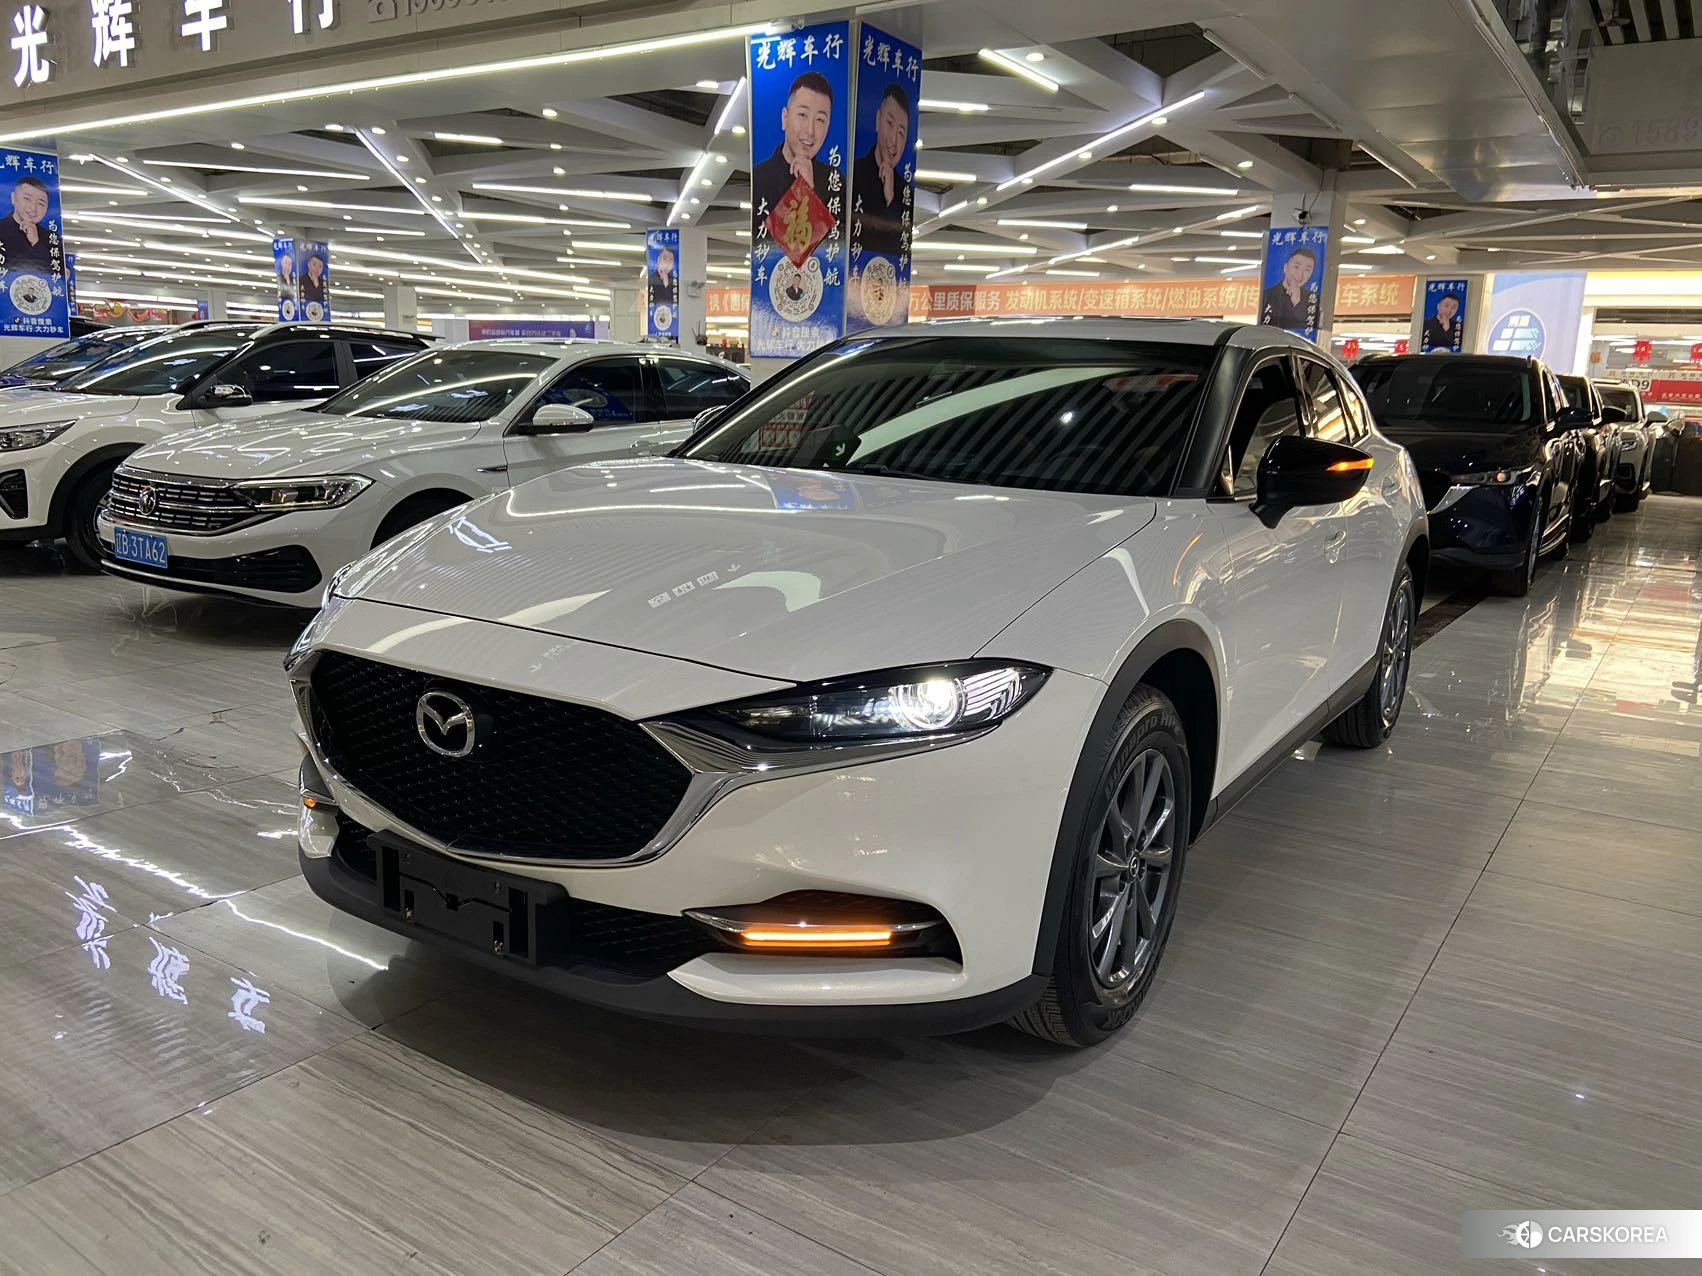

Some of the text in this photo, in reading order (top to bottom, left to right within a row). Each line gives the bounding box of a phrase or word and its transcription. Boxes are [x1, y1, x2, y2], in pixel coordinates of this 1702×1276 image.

[756, 34, 844, 70] 光辉车行
[863, 35, 919, 82] 光辉车行
[0, 154, 55, 175] 辉车行
[783, 195, 813, 254] 福
[1272, 231, 1326, 246] 光辉车行
